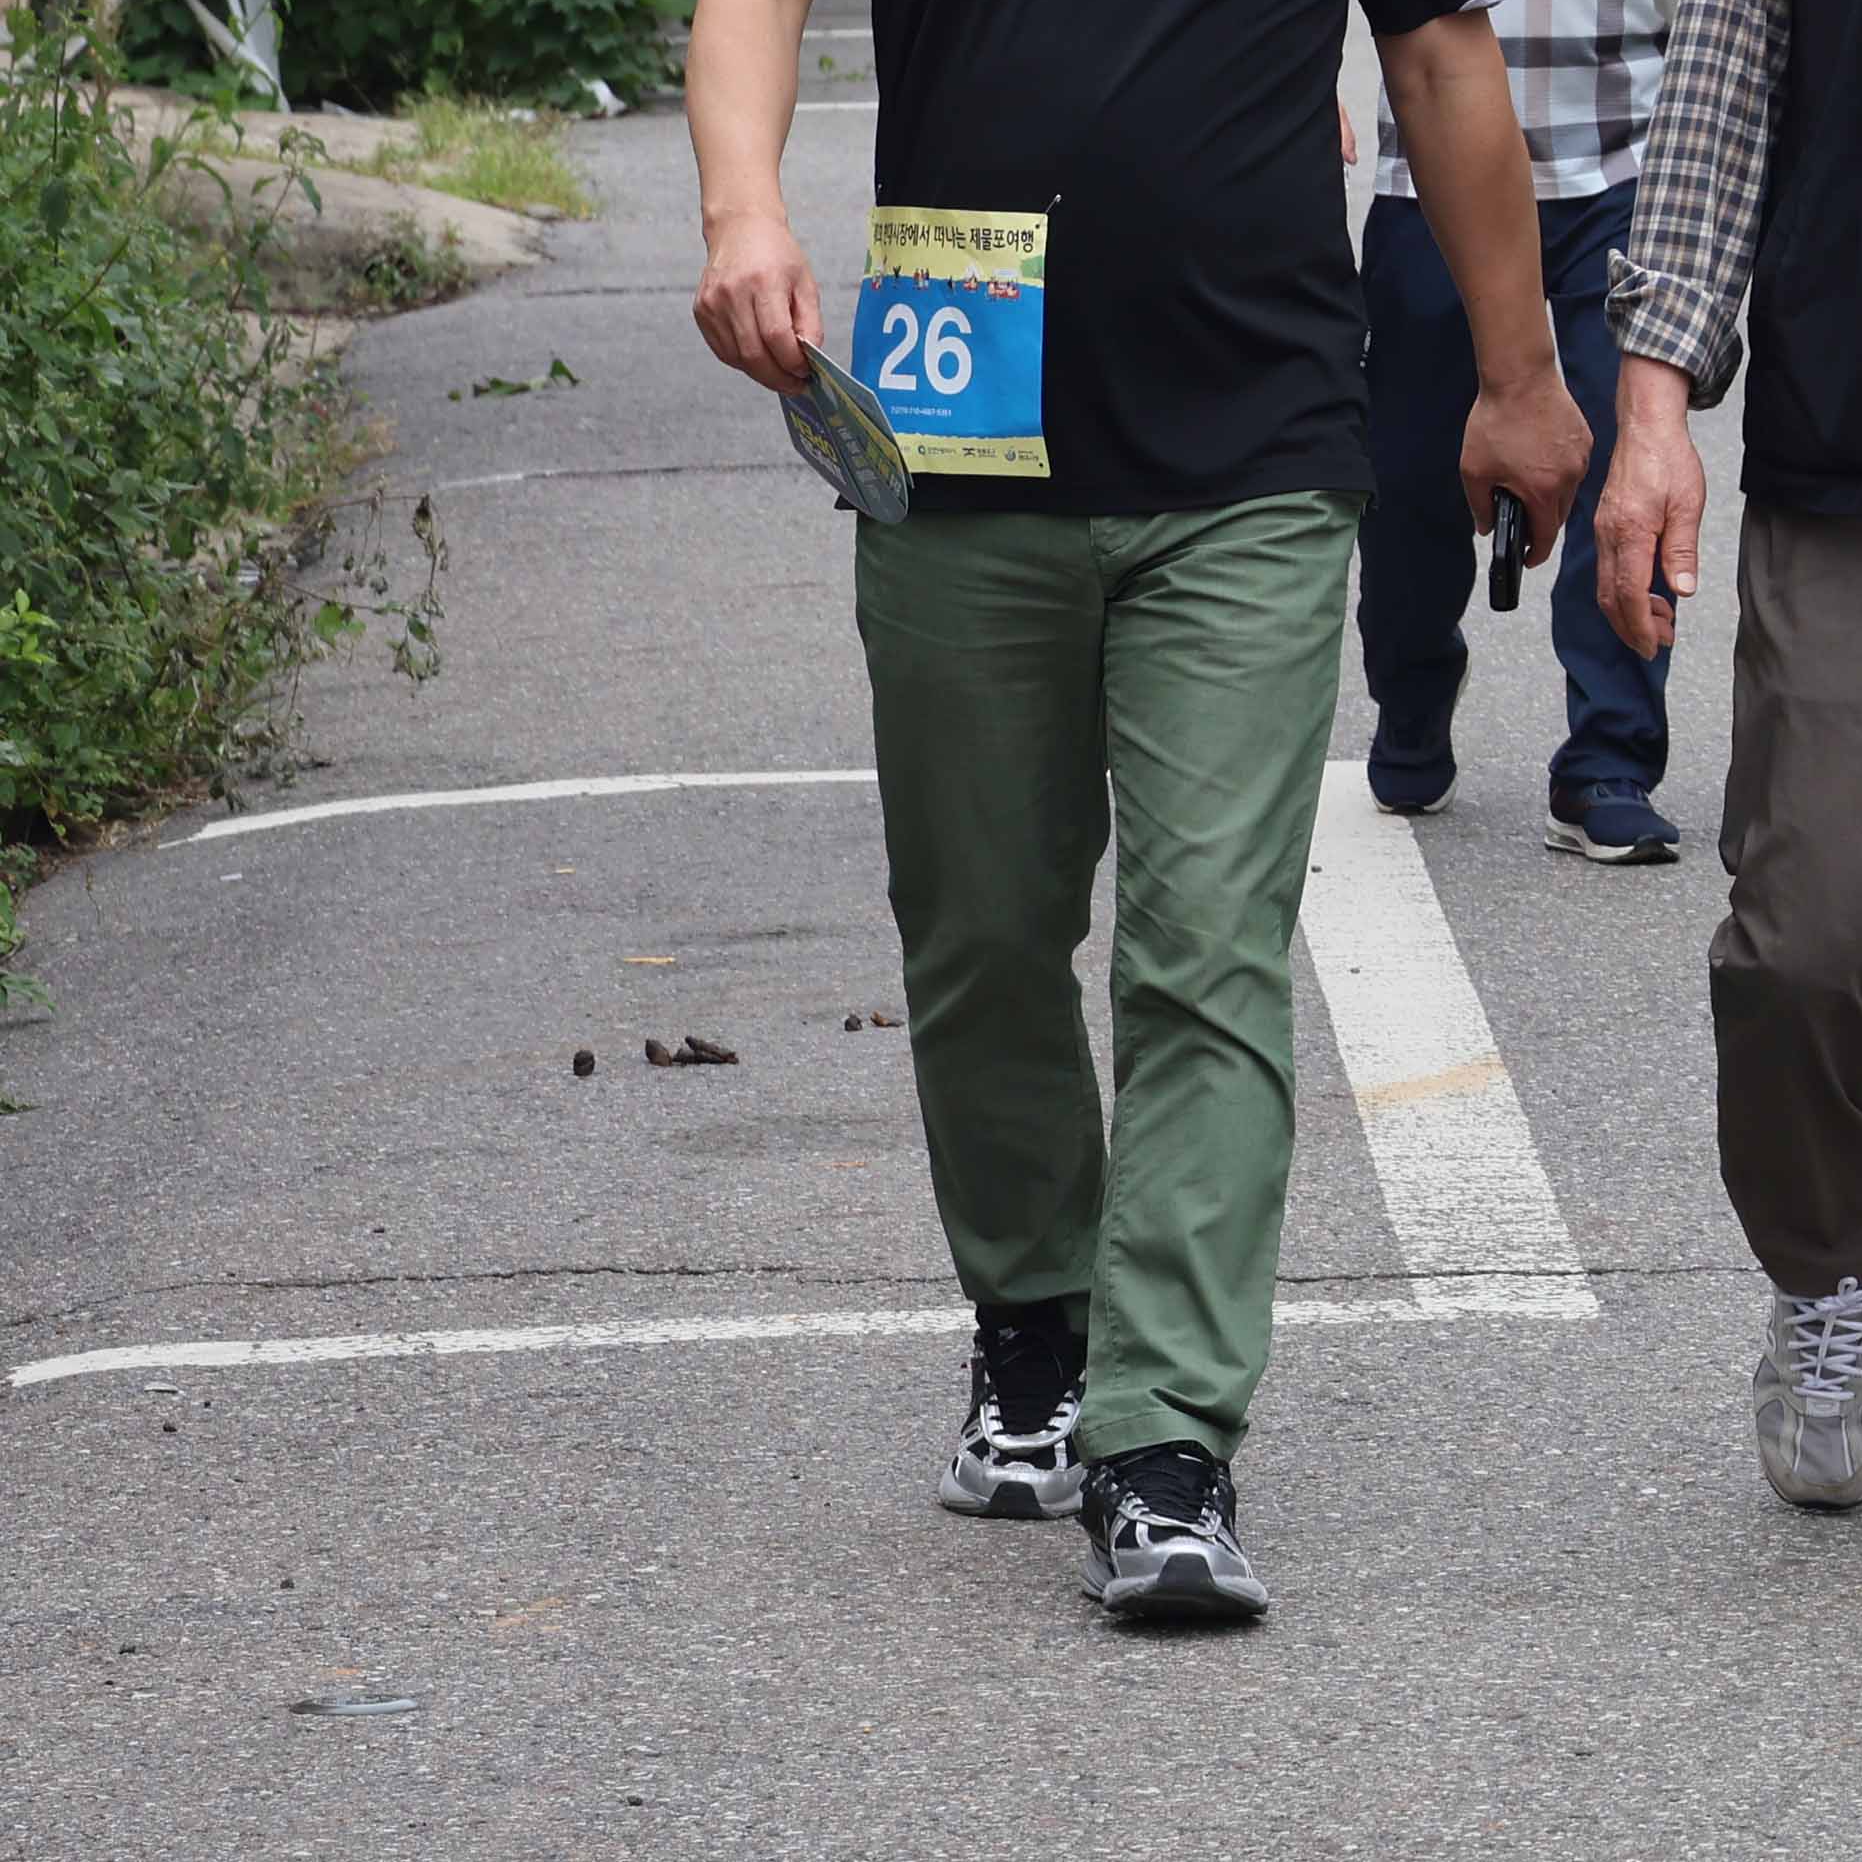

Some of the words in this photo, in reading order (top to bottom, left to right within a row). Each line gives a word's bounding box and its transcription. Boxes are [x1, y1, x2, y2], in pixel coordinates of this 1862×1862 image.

[934, 224, 966, 250] 떠나는
[970, 227, 1034, 254] 제물포여행
[878, 302, 973, 396] 26
